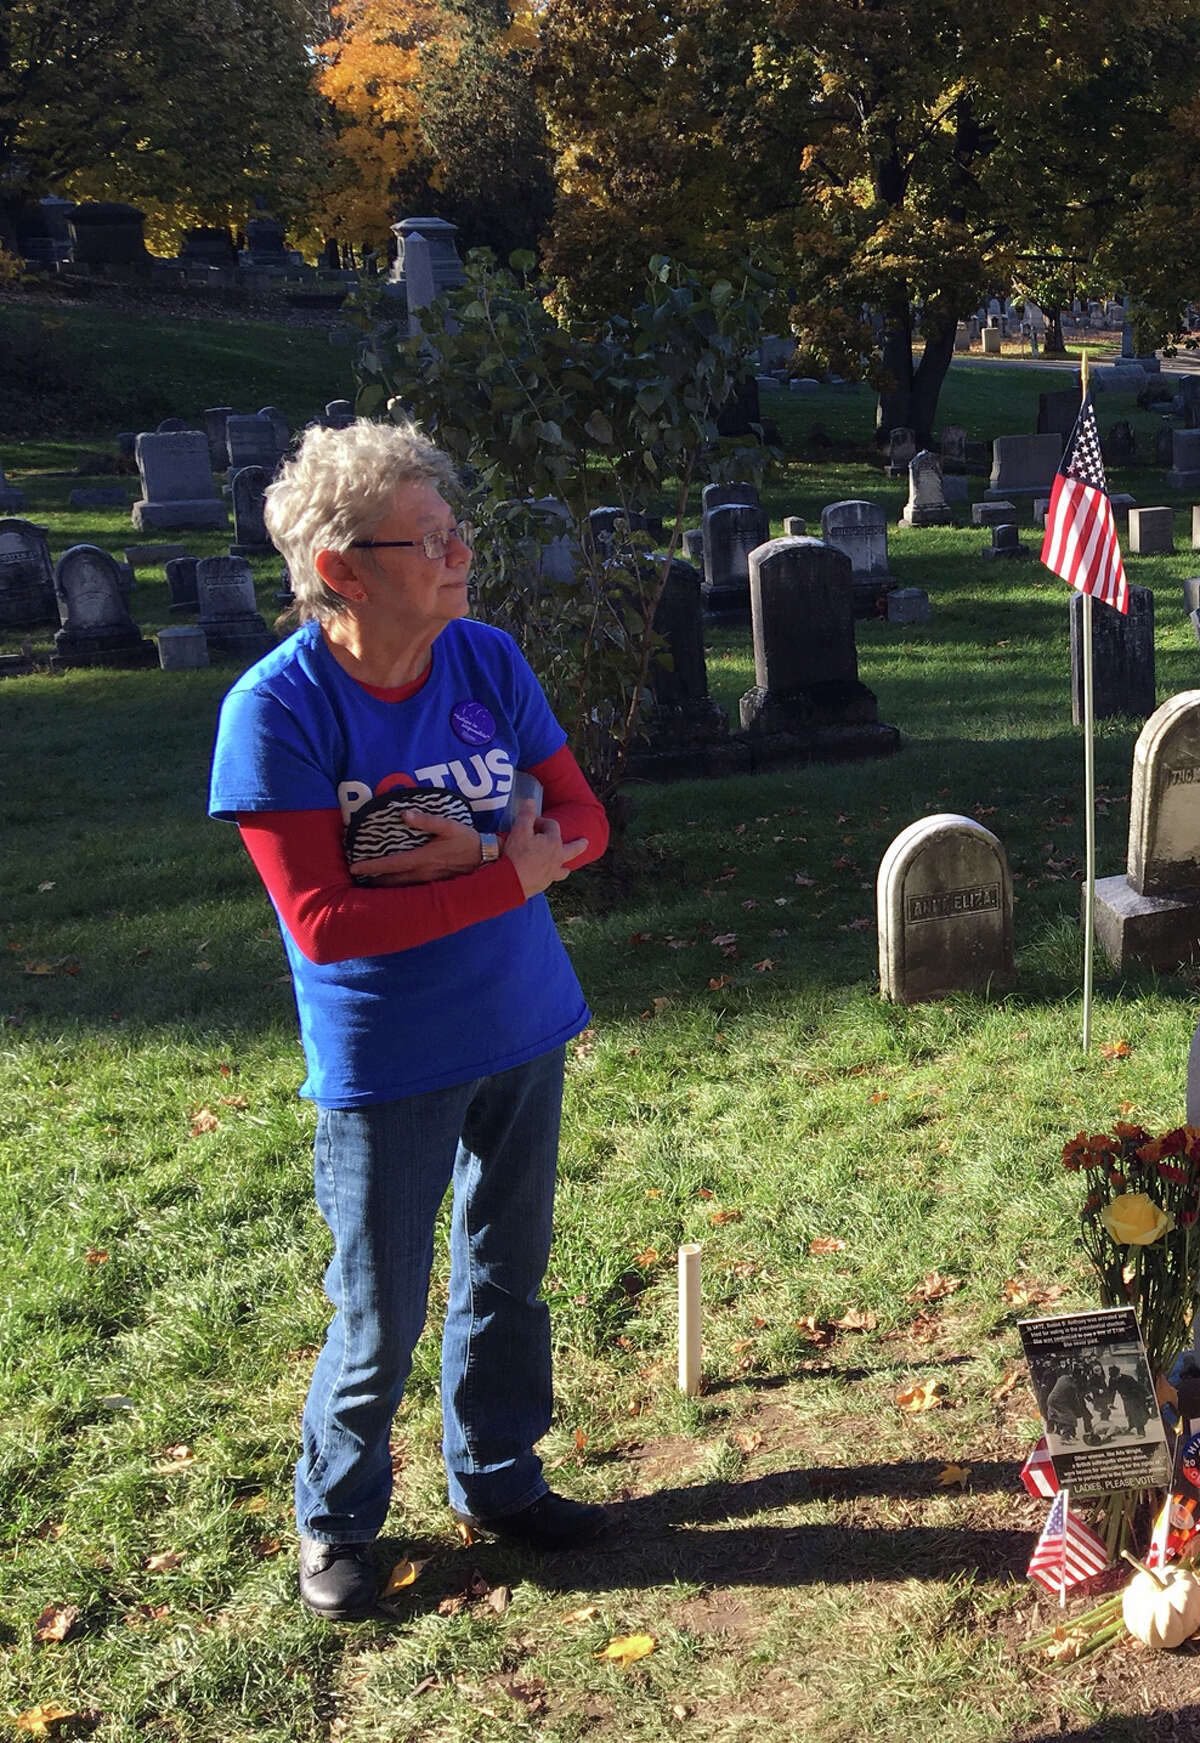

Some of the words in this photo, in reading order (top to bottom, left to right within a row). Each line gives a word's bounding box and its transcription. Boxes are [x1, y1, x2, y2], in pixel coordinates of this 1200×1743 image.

[1183, 1458, 1196, 1468] 20
[1073, 1482, 1105, 1494] LADIES,
[1105, 1478, 1135, 1489] PLEASE
[1135, 1475, 1157, 1485] VOTE
